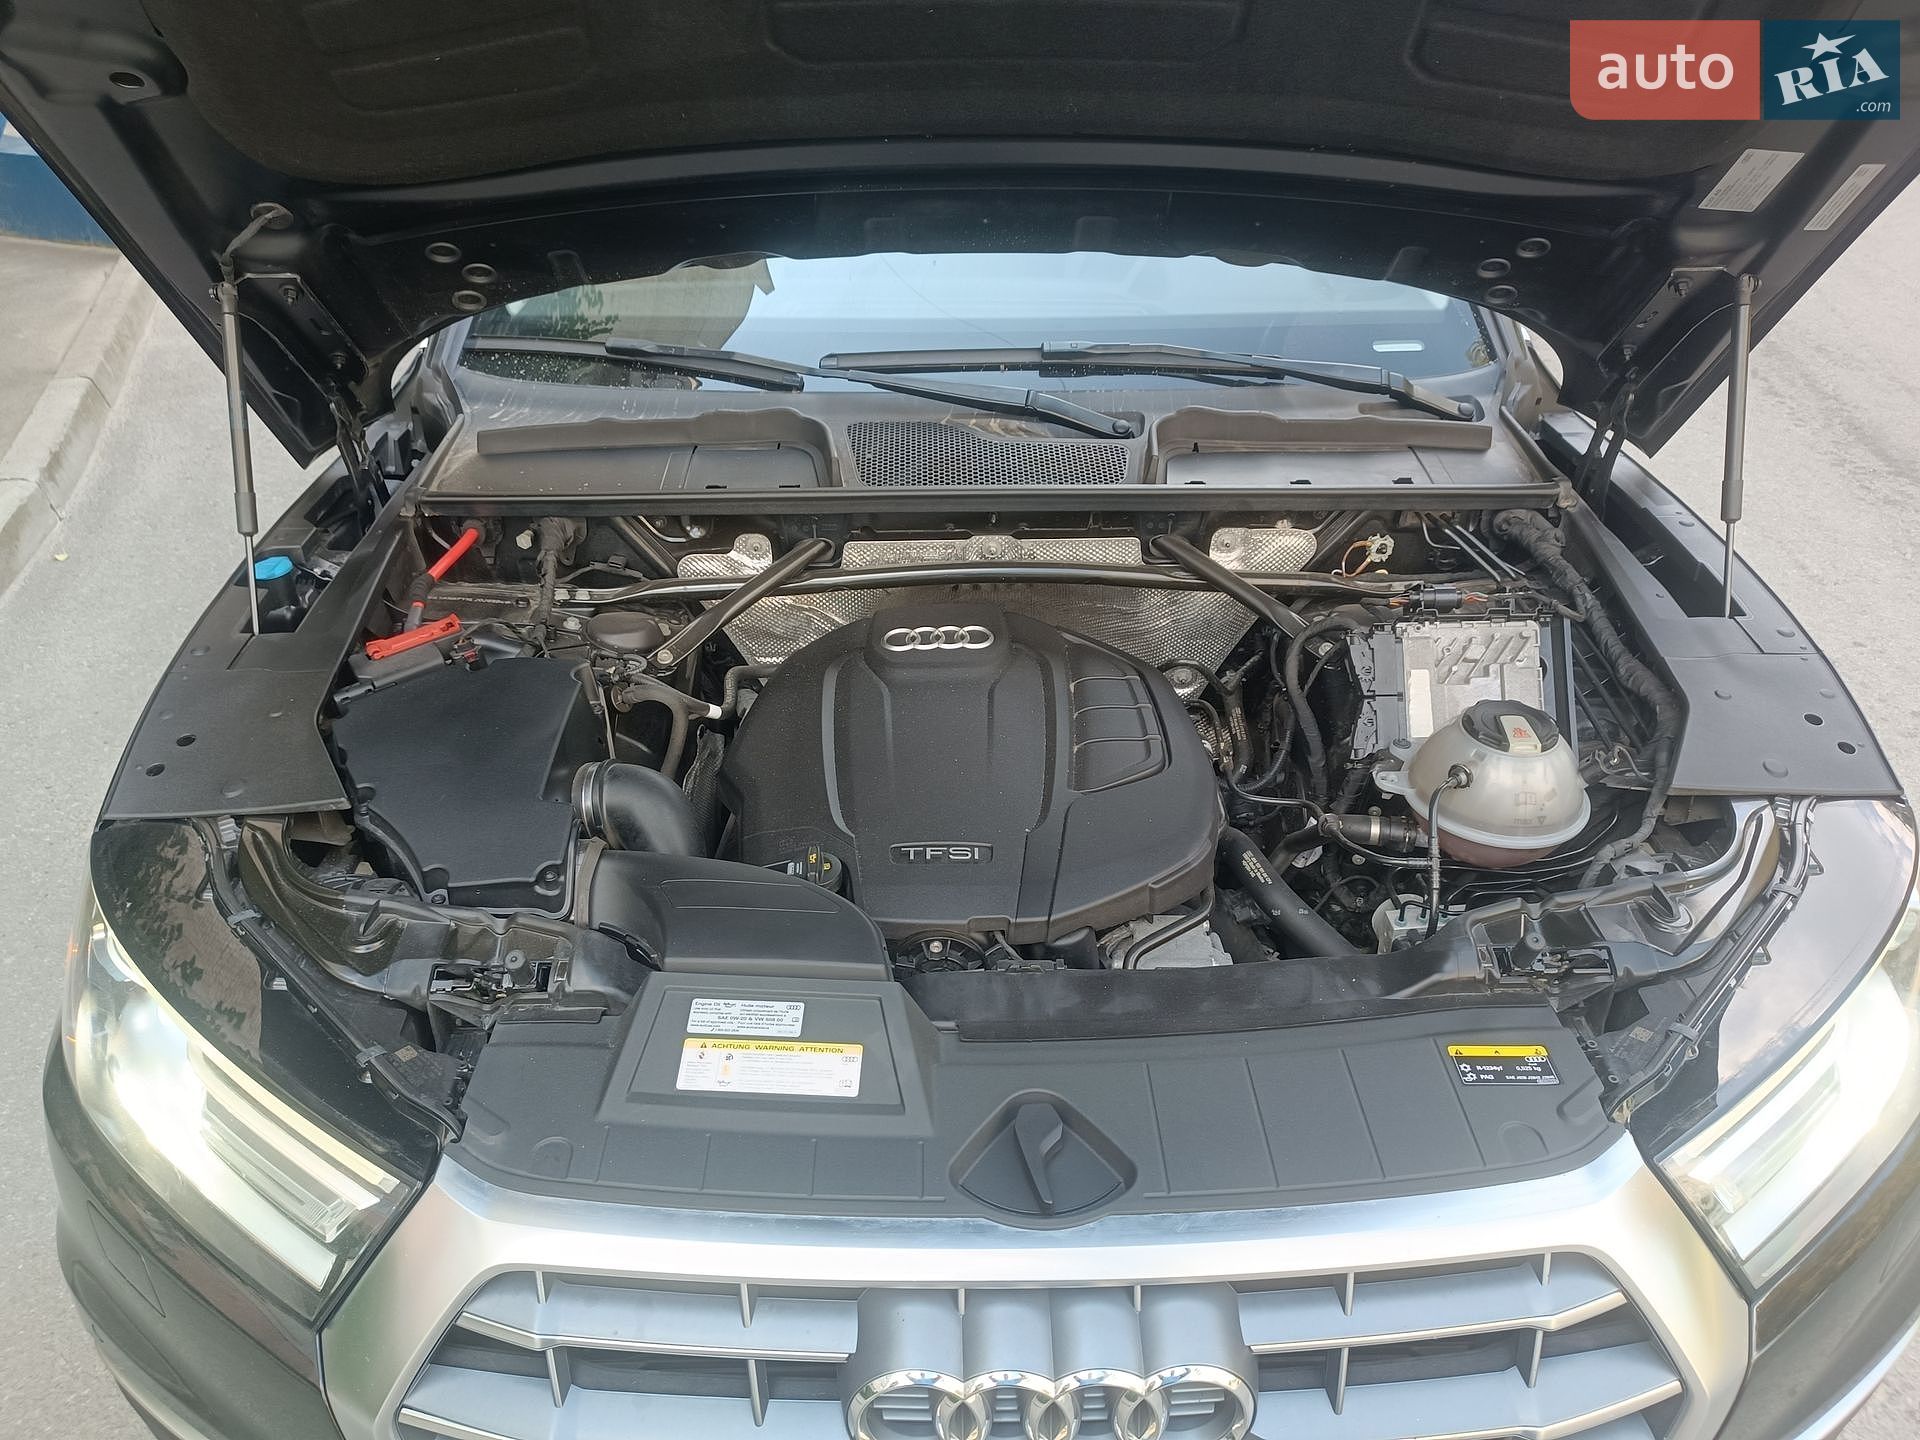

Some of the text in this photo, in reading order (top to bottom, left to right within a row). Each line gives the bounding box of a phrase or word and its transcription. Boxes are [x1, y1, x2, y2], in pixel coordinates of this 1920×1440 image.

[901, 847, 979, 860] TFSI
[755, 1044, 794, 1052] WARNING
[799, 1046, 843, 1054] ATTENTION
